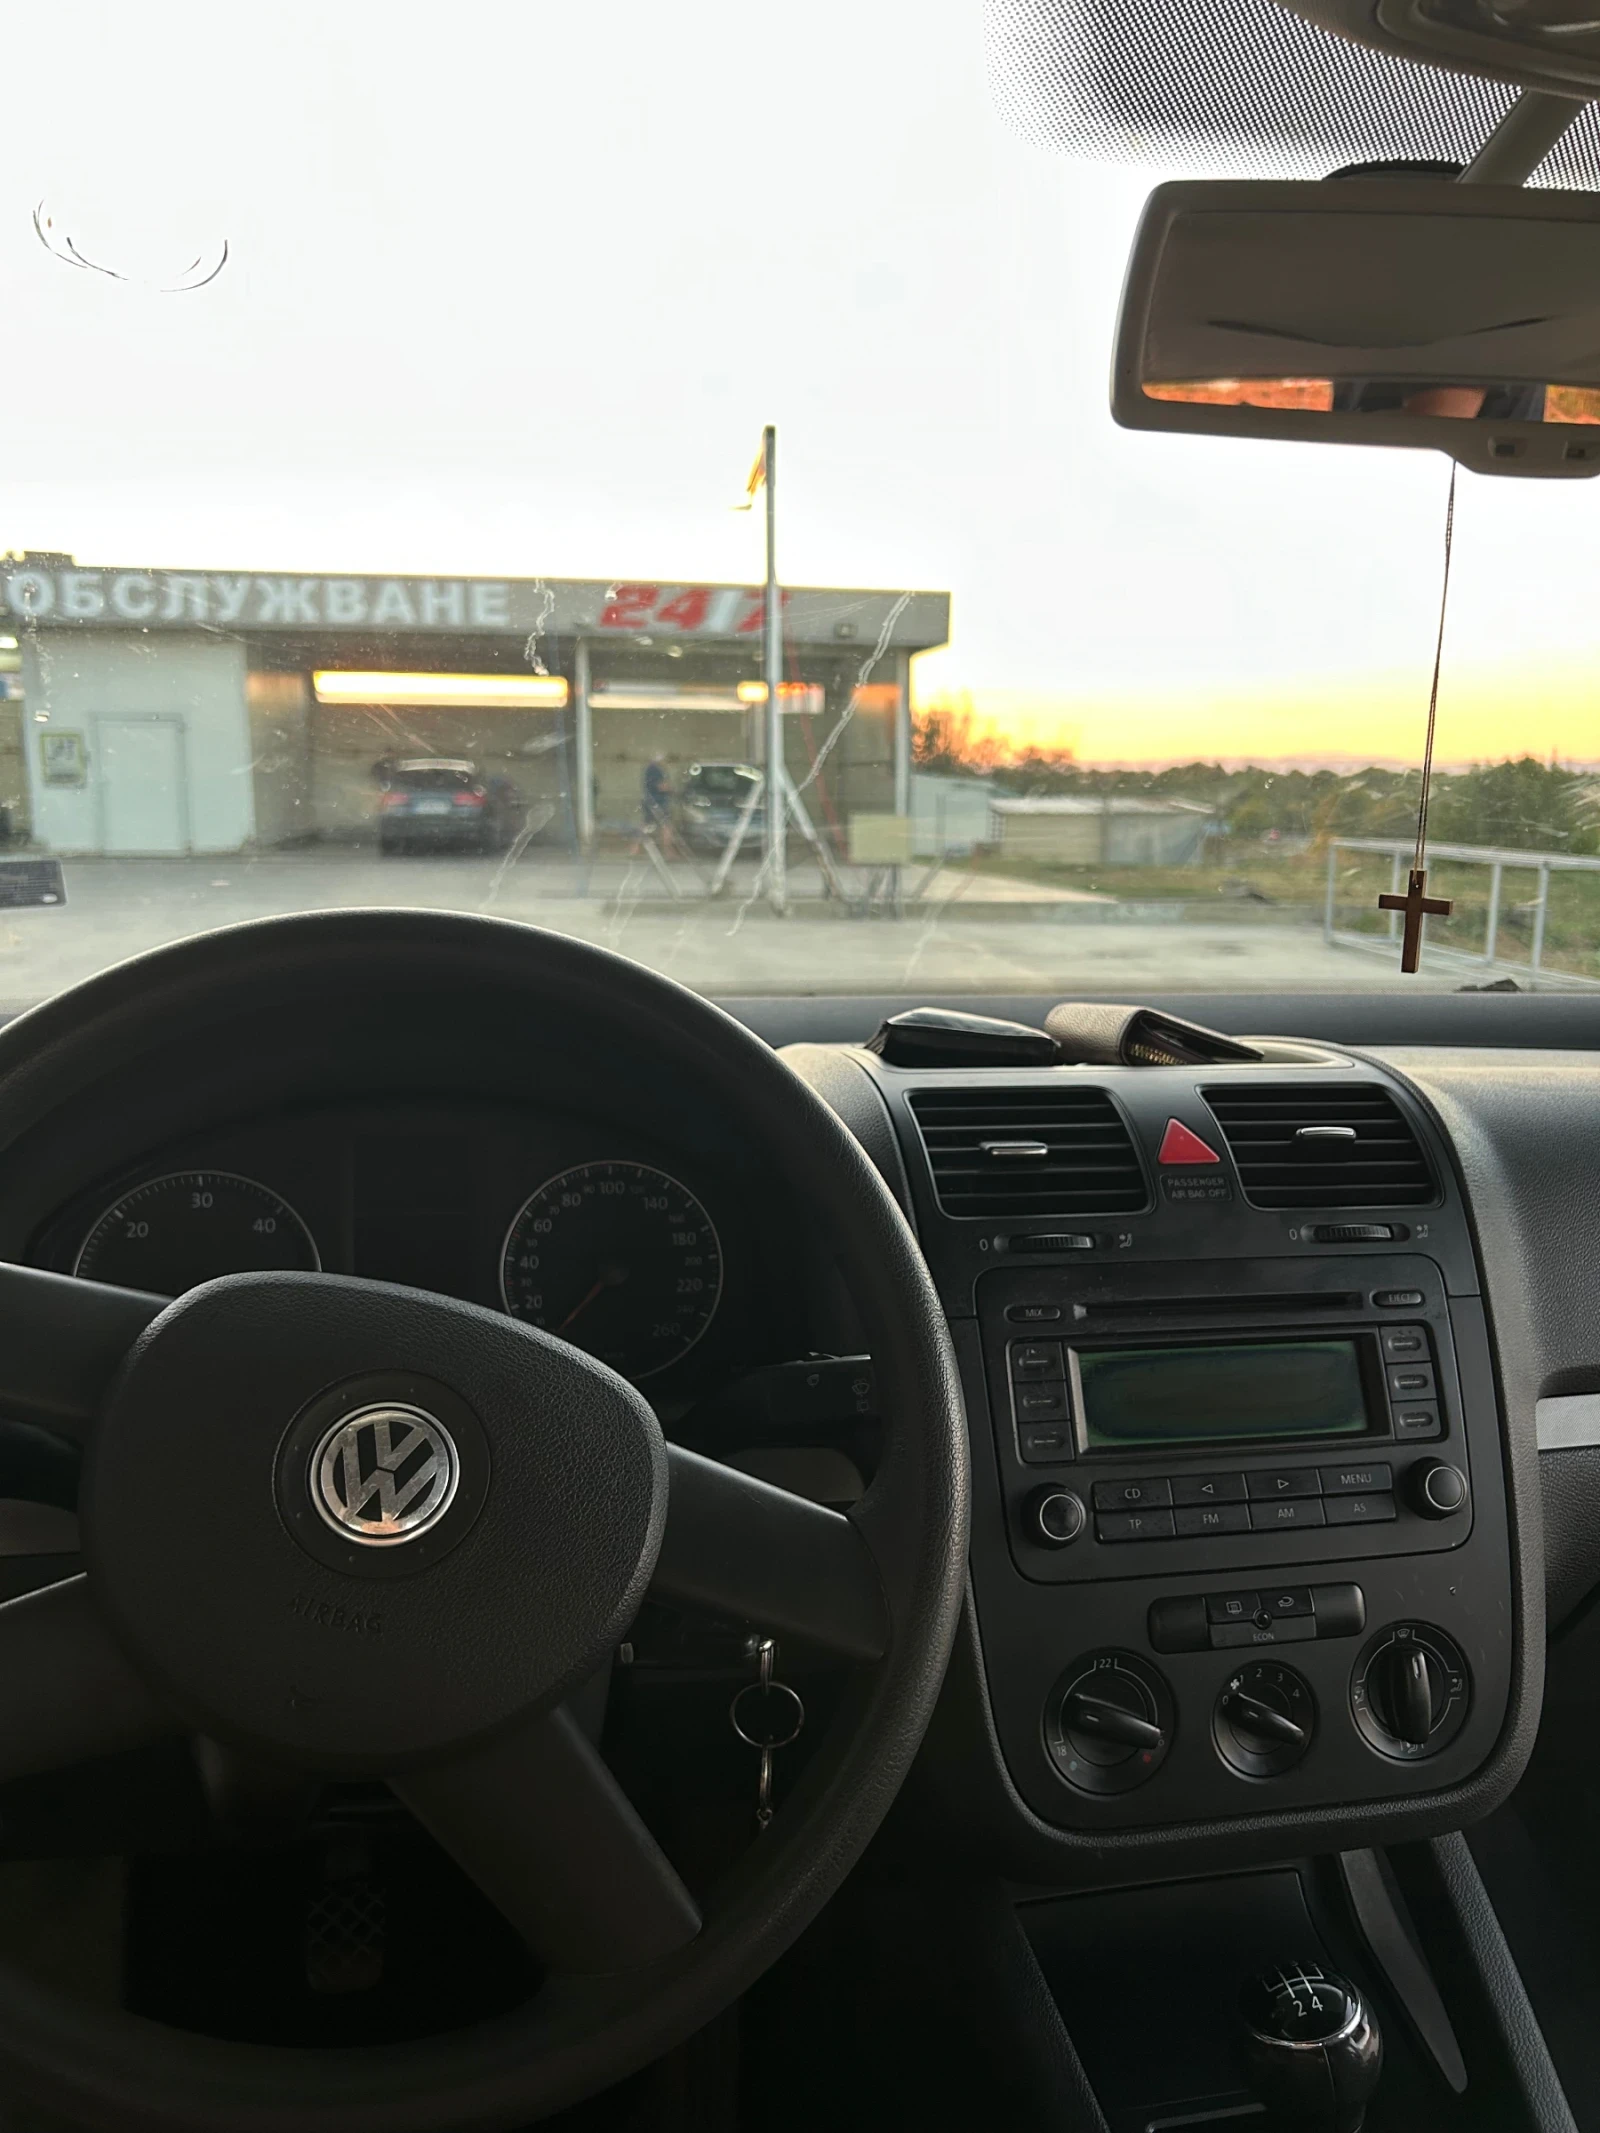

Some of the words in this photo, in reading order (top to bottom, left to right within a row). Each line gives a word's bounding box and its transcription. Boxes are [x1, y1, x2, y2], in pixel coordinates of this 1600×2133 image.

[8, 571, 509, 626] ОБСЛУЖВАНЕ
[600, 582, 790, 633] 24/7
[599, 1180, 625, 1196] 100
[1168, 1177, 1224, 1188] PASSENGER
[191, 1191, 213, 1209] 30
[562, 1192, 581, 1208] 80
[1171, 1189, 1186, 1199] AIR
[1208, 1188, 1227, 1199] OFF
[643, 1196, 668, 1211] 140
[126, 1221, 149, 1239] 20
[253, 1217, 276, 1234] 40
[533, 1218, 552, 1234] 60
[672, 1231, 697, 1246] 180
[520, 1255, 539, 1270] 40
[676, 1278, 703, 1293] 220
[525, 1295, 543, 1310] 20
[1025, 1308, 1043, 1318] MIX
[1341, 1473, 1373, 1486] MENU
[1124, 1487, 1141, 1500] CD
[1278, 1508, 1296, 1520] AM
[1353, 1502, 1367, 1514] AS
[1129, 1519, 1142, 1531] TP
[1203, 1513, 1219, 1525] FM
[290, 1596, 382, 1635] AIRBAG
[1253, 1631, 1275, 1642] ECON
[1099, 1657, 1112, 1669] 22
[1255, 1667, 1263, 1678] 2
[1277, 1672, 1284, 1682] 3
[1292, 1688, 1300, 1699] 4
[1056, 1745, 1068, 1757] 18
[1292, 2000, 1307, 2018] 2
[1311, 1995, 1324, 2012] 4
